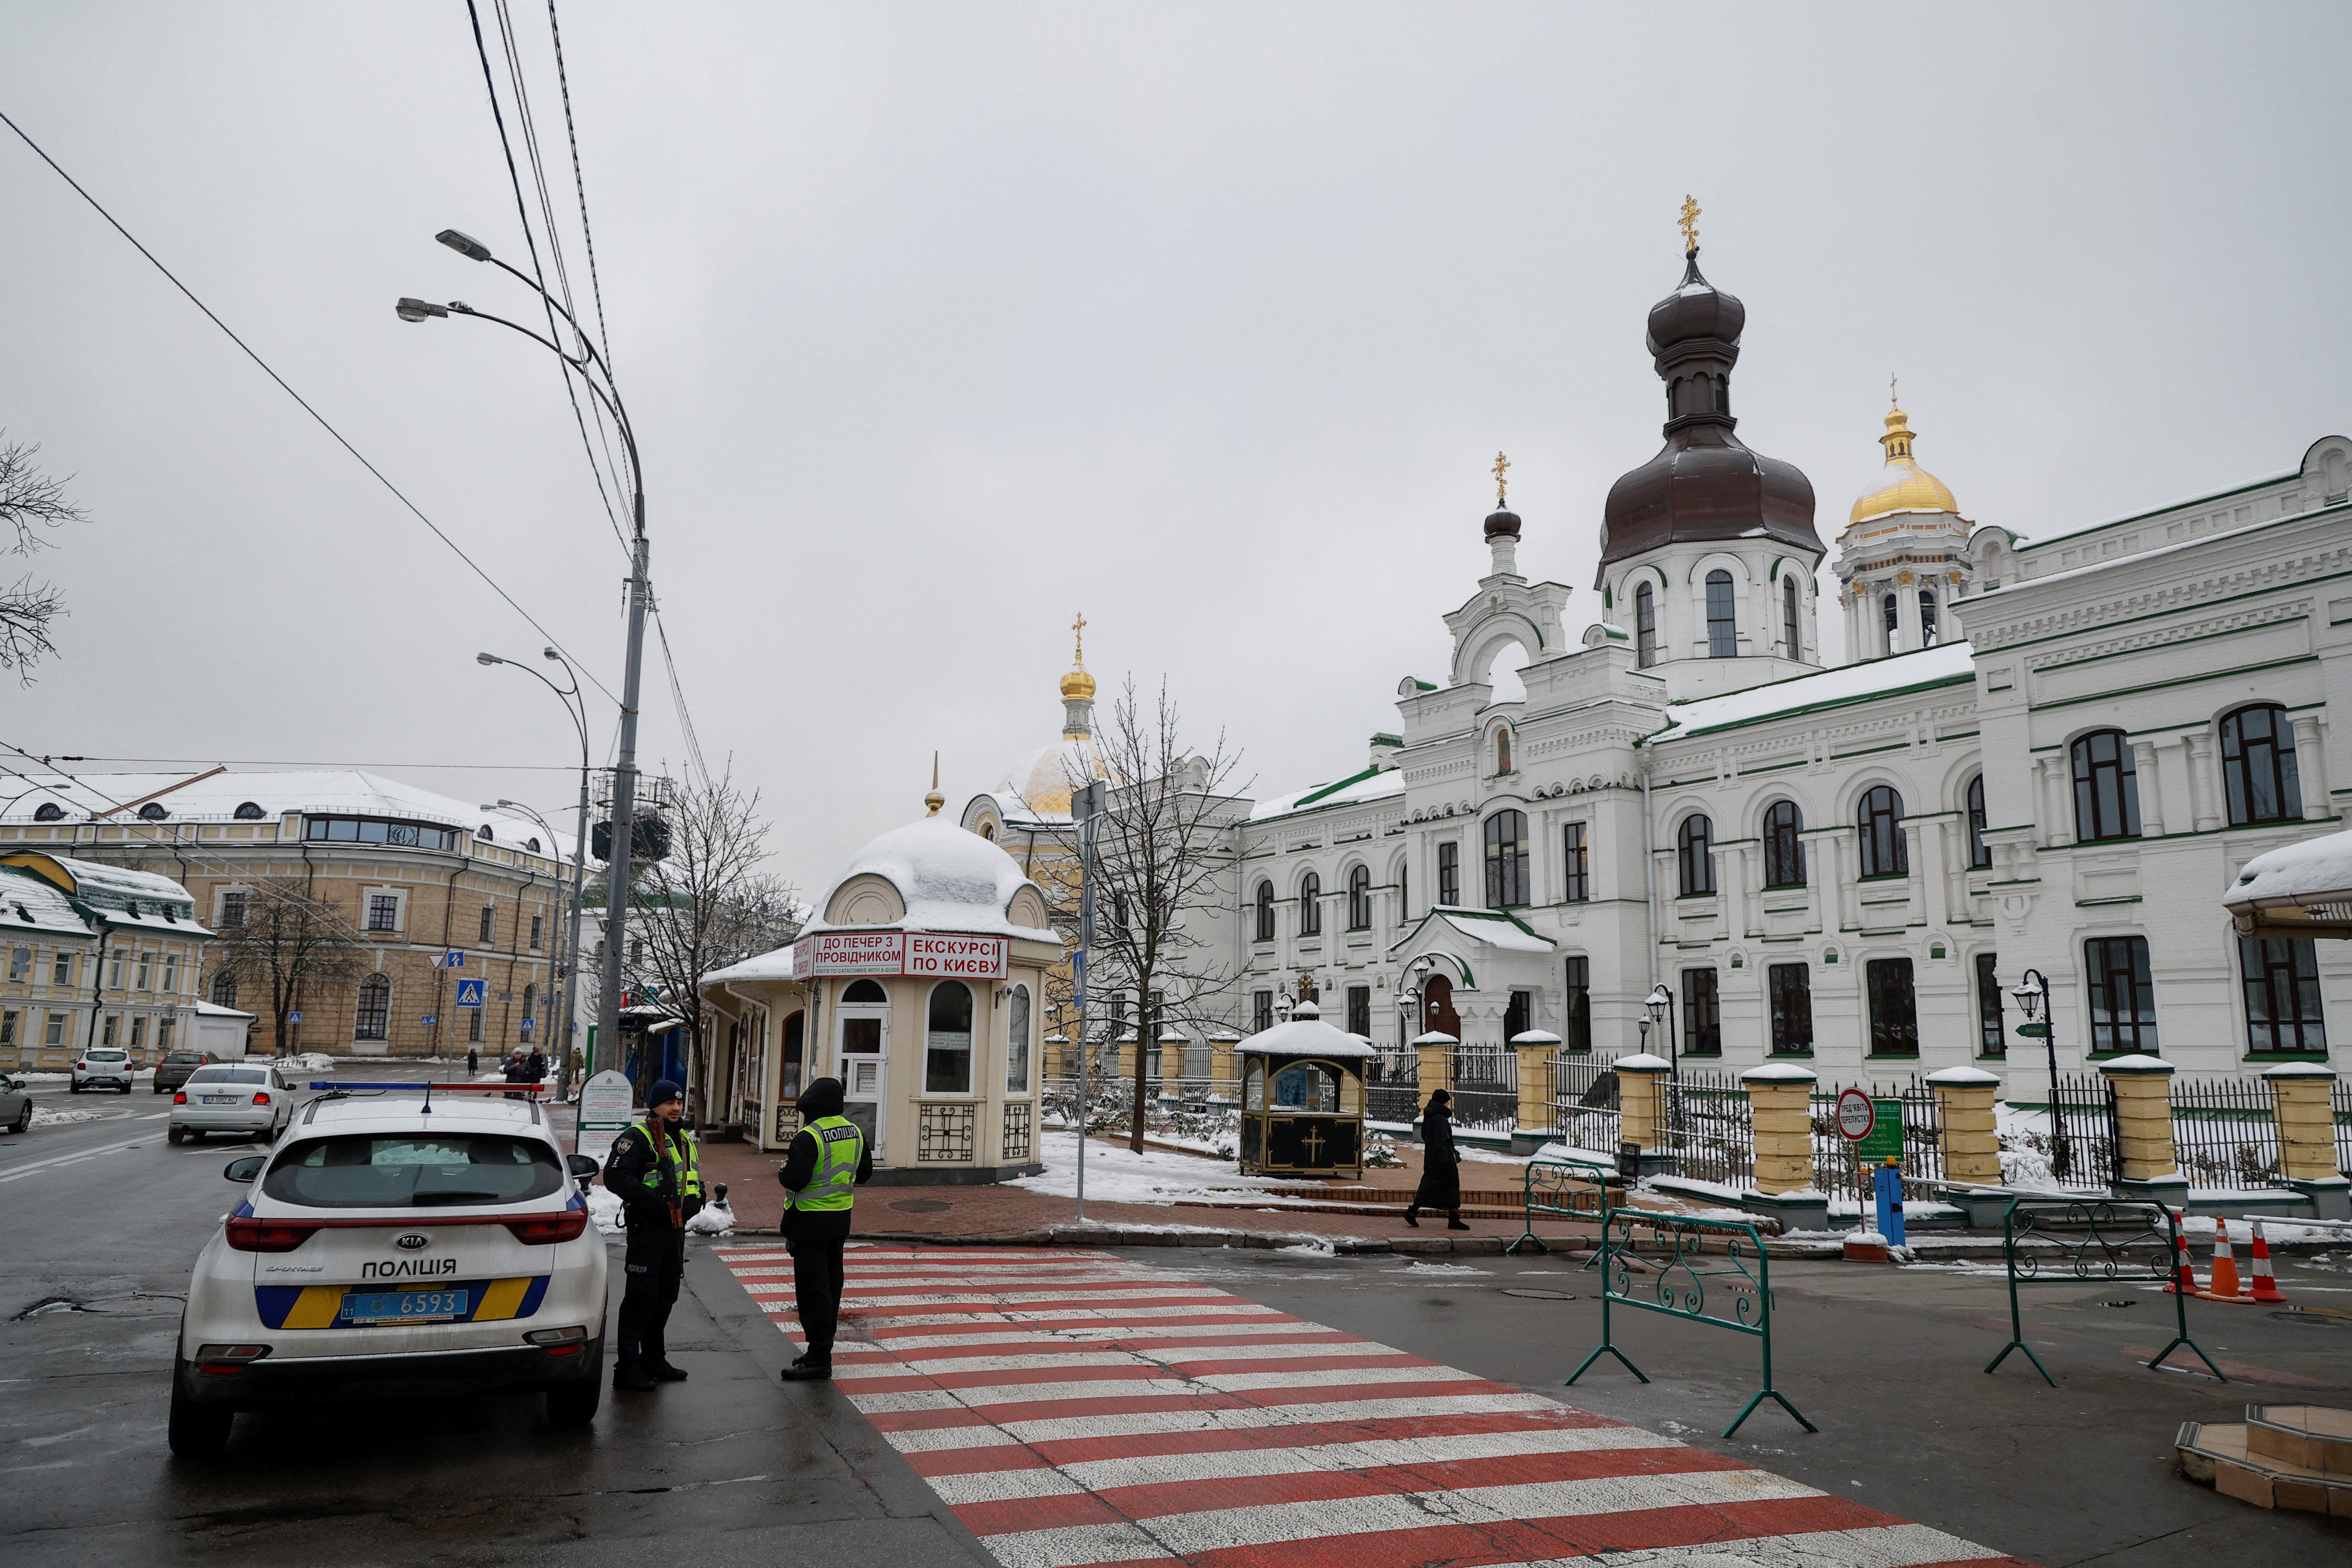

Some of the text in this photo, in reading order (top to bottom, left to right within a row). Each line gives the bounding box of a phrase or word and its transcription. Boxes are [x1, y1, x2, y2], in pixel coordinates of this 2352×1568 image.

[824, 938, 840, 951] ДО
[844, 937, 882, 948] ПЕЧЕР
[913, 939, 1001, 956] ЕКСКУРСІЇ
[815, 951, 900, 964] ПРОВІДНИКОМ
[914, 957, 1000, 973] ПО КИЄВУ
[1841, 1103, 1868, 1113] ПРЕД'ЯВІТЬ
[1841, 1114, 1870, 1124] ПЕРЕПУСТКУ
[823, 1127, 858, 1142] ПОЛІЦІЯ
[402, 1237, 423, 1246] KIA
[362, 1258, 456, 1278] ПОЛІЦІЯ
[628, 1264, 647, 1273] ПОЛІЦІЯ
[344, 1294, 455, 1316] 11 6593
